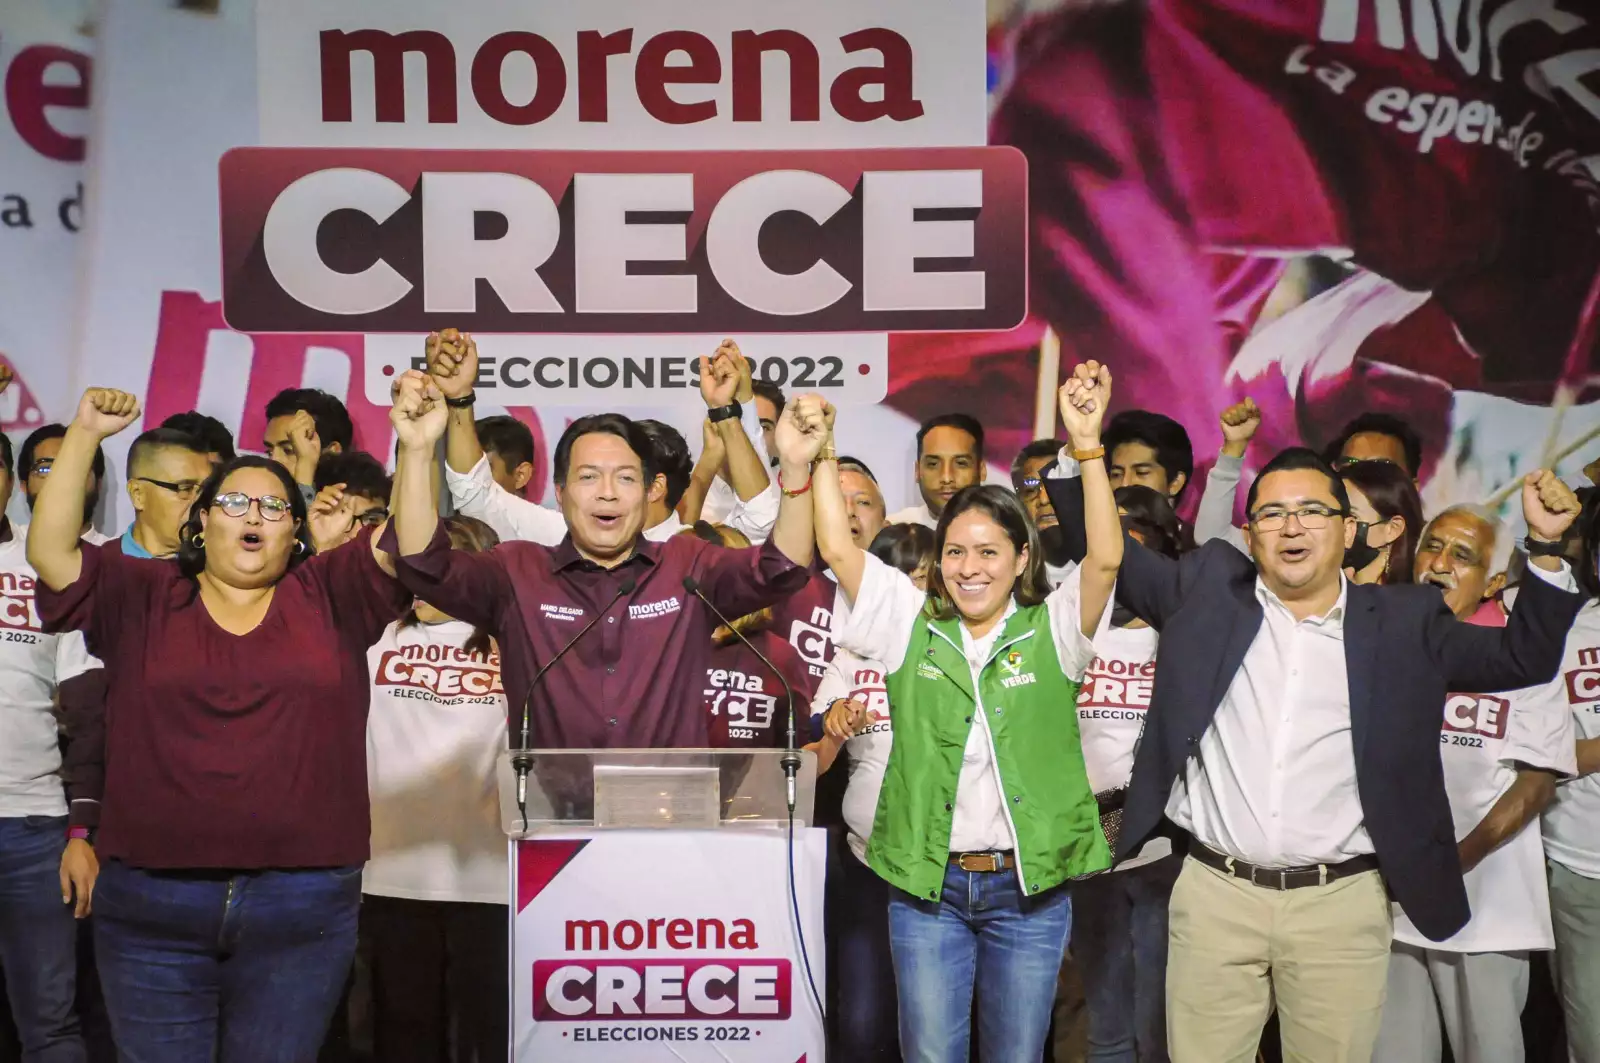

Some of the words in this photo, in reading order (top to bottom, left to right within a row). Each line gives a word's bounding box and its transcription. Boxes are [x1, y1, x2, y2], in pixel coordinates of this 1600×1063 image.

[319, 27, 924, 126] morena
[263, 167, 985, 316] CRECE
[629, 597, 679, 616] morena
[6, 632, 36, 644] 2022
[1000, 672, 1037, 688] VERDE
[394, 688, 464, 706] ELECCIONES
[467, 696, 495, 705] 2022
[1452, 736, 1483, 748] 2022
[564, 918, 759, 951] morena
[545, 964, 779, 1016] CRECE
[573, 1027, 699, 1042] ELECCIONES
[704, 1026, 751, 1041] 2022
